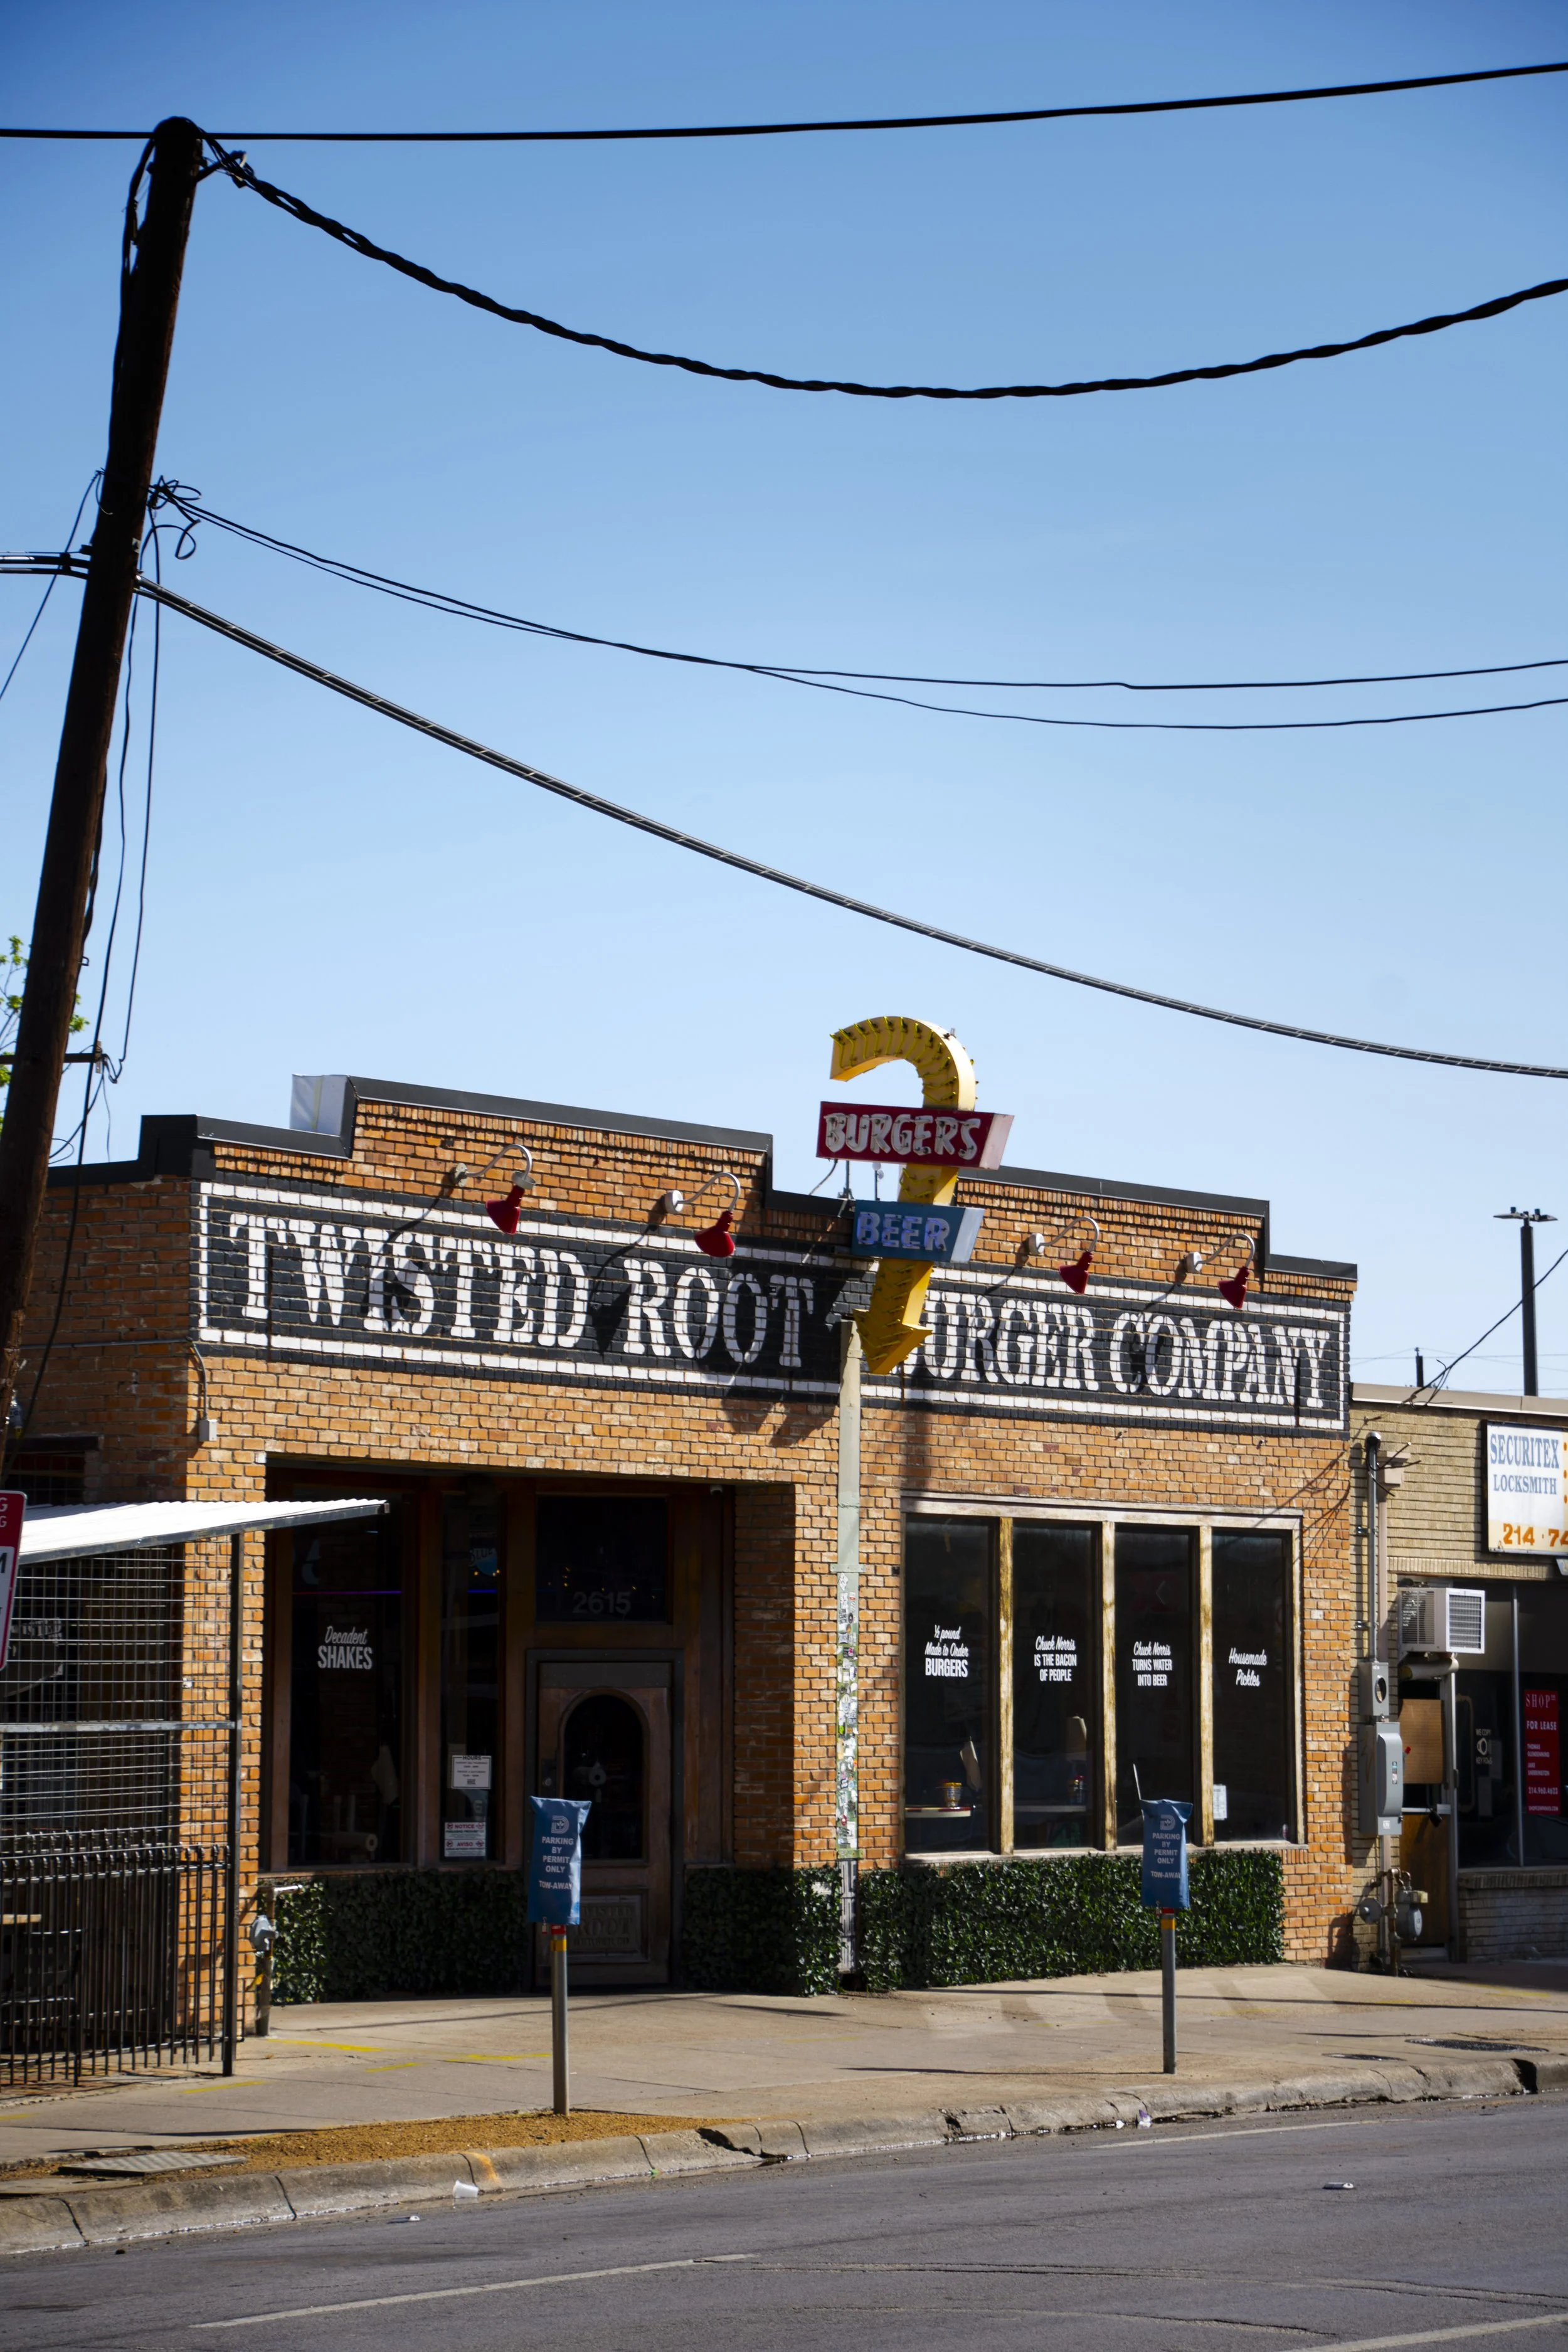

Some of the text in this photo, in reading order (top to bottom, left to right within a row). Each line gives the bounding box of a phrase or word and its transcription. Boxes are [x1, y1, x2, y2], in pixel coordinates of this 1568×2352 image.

[824, 1113, 982, 1160] BURGERS
[857, 1211, 950, 1252] BEER
[230, 1213, 590, 1348] TWISTED
[623, 1259, 814, 1368] ROOT
[1110, 1312, 1330, 1409] COMPANY
[1490, 1433, 1560, 1470] SECURITEX
[1493, 1475, 1557, 1495] LOCKSMITH
[1503, 1522, 1535, 1546] 214
[573, 1591, 631, 1614] 2615
[324, 1625, 368, 1645] Decadent
[940, 1626, 961, 1643] pound
[1036, 1634, 1076, 1651] Chuck Norris
[924, 1641, 969, 1657] Made to Order
[1133, 1641, 1172, 1656] Chuck Norris
[1229, 1647, 1268, 1666] Housemade
[317, 1645, 373, 1670] SHAKES
[1034, 1654, 1077, 1666] IS THE BACON
[1131, 1658, 1172, 1671] TURNS WATER
[925, 1658, 968, 1677] BURGERS
[1039, 1669, 1072, 1682] OF PEOPLE
[1137, 1674, 1167, 1686] INTO BEER
[1236, 1668, 1261, 1687] Pickles
[1525, 1693, 1550, 1708] SHOP
[1527, 1720, 1557, 1731] FOR LEASE
[541, 1836, 574, 1845] PARKING
[1152, 1832, 1180, 1840] PARKING
[543, 1855, 570, 1864] PERMIT
[1154, 1848, 1178, 1857] PERMIT
[545, 1865, 566, 1873] ONLY
